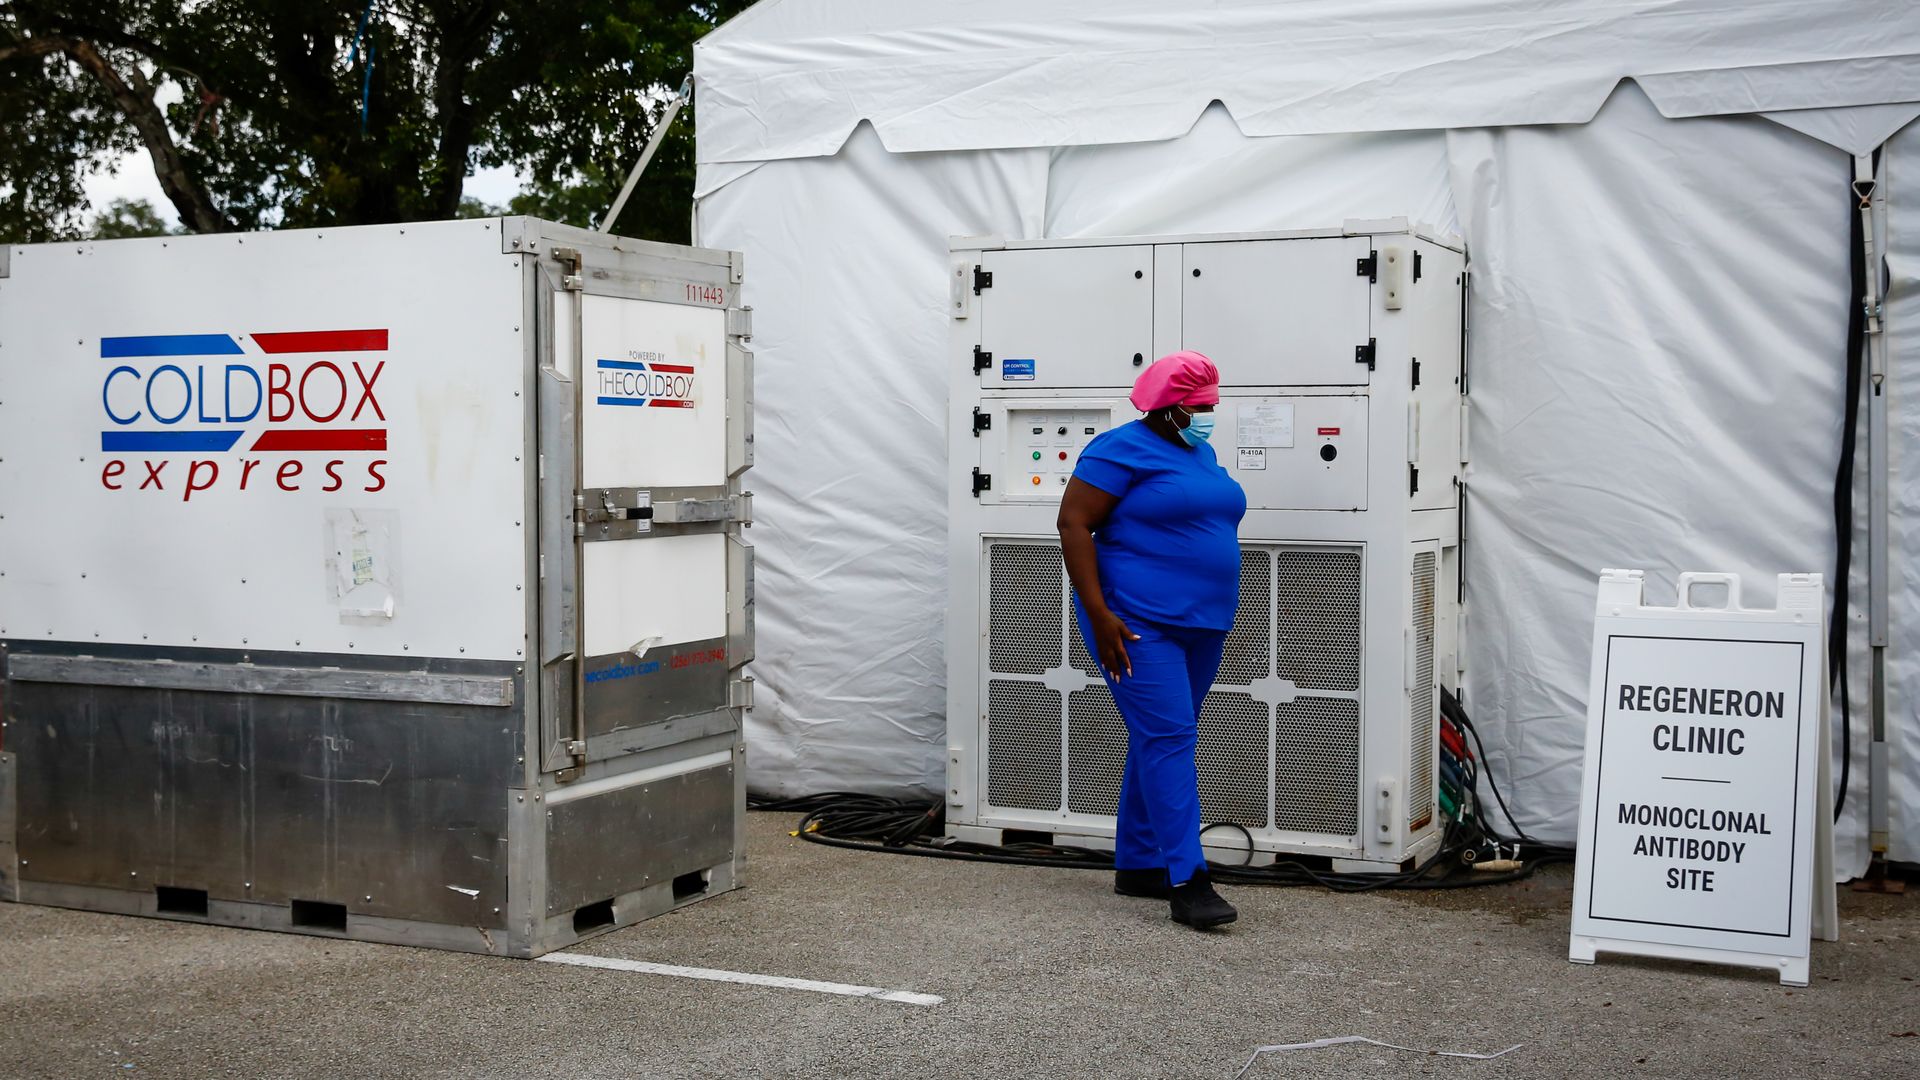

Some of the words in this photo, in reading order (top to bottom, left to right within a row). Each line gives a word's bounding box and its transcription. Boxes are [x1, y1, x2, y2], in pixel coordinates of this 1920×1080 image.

[686, 284, 723, 304] 111443
[629, 350, 657, 361] POWERED
[657, 353, 665, 362] BY
[102, 360, 386, 425] COLDBOX
[101, 459, 387, 502] express
[1618, 684, 1785, 719] REGENERON
[1652, 724, 1746, 756] CLINIC
[1618, 803, 1772, 835] MONOCLONAL
[1633, 835, 1746, 864] ANTIBODY
[1666, 867, 1715, 892] SITE
